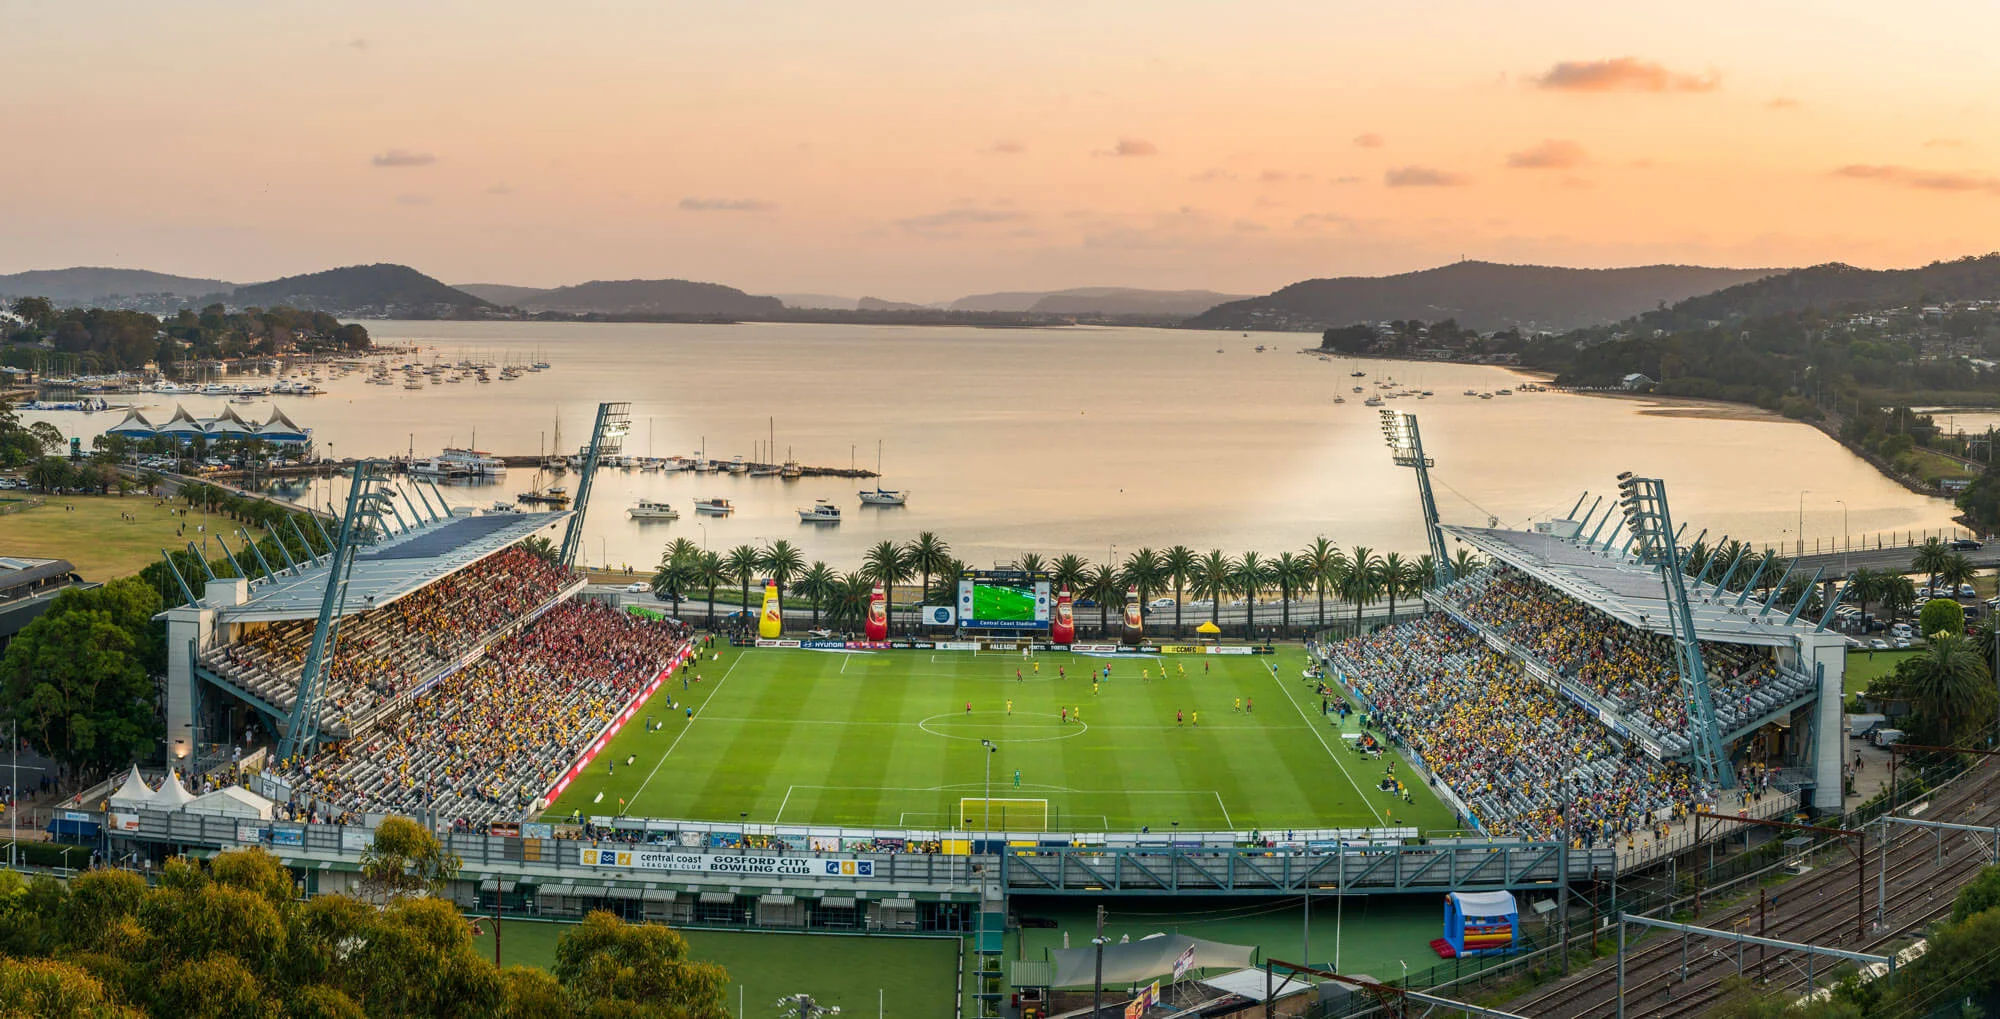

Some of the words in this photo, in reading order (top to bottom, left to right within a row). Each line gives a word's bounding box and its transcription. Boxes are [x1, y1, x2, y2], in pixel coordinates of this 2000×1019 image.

[641, 854, 674, 862] central
[676, 855, 702, 864] coast
[713, 856, 776, 865] GOSFORD
[780, 858, 808, 866] CITY
[710, 863, 773, 872] BOWLING
[777, 866, 811, 874] CLUB
